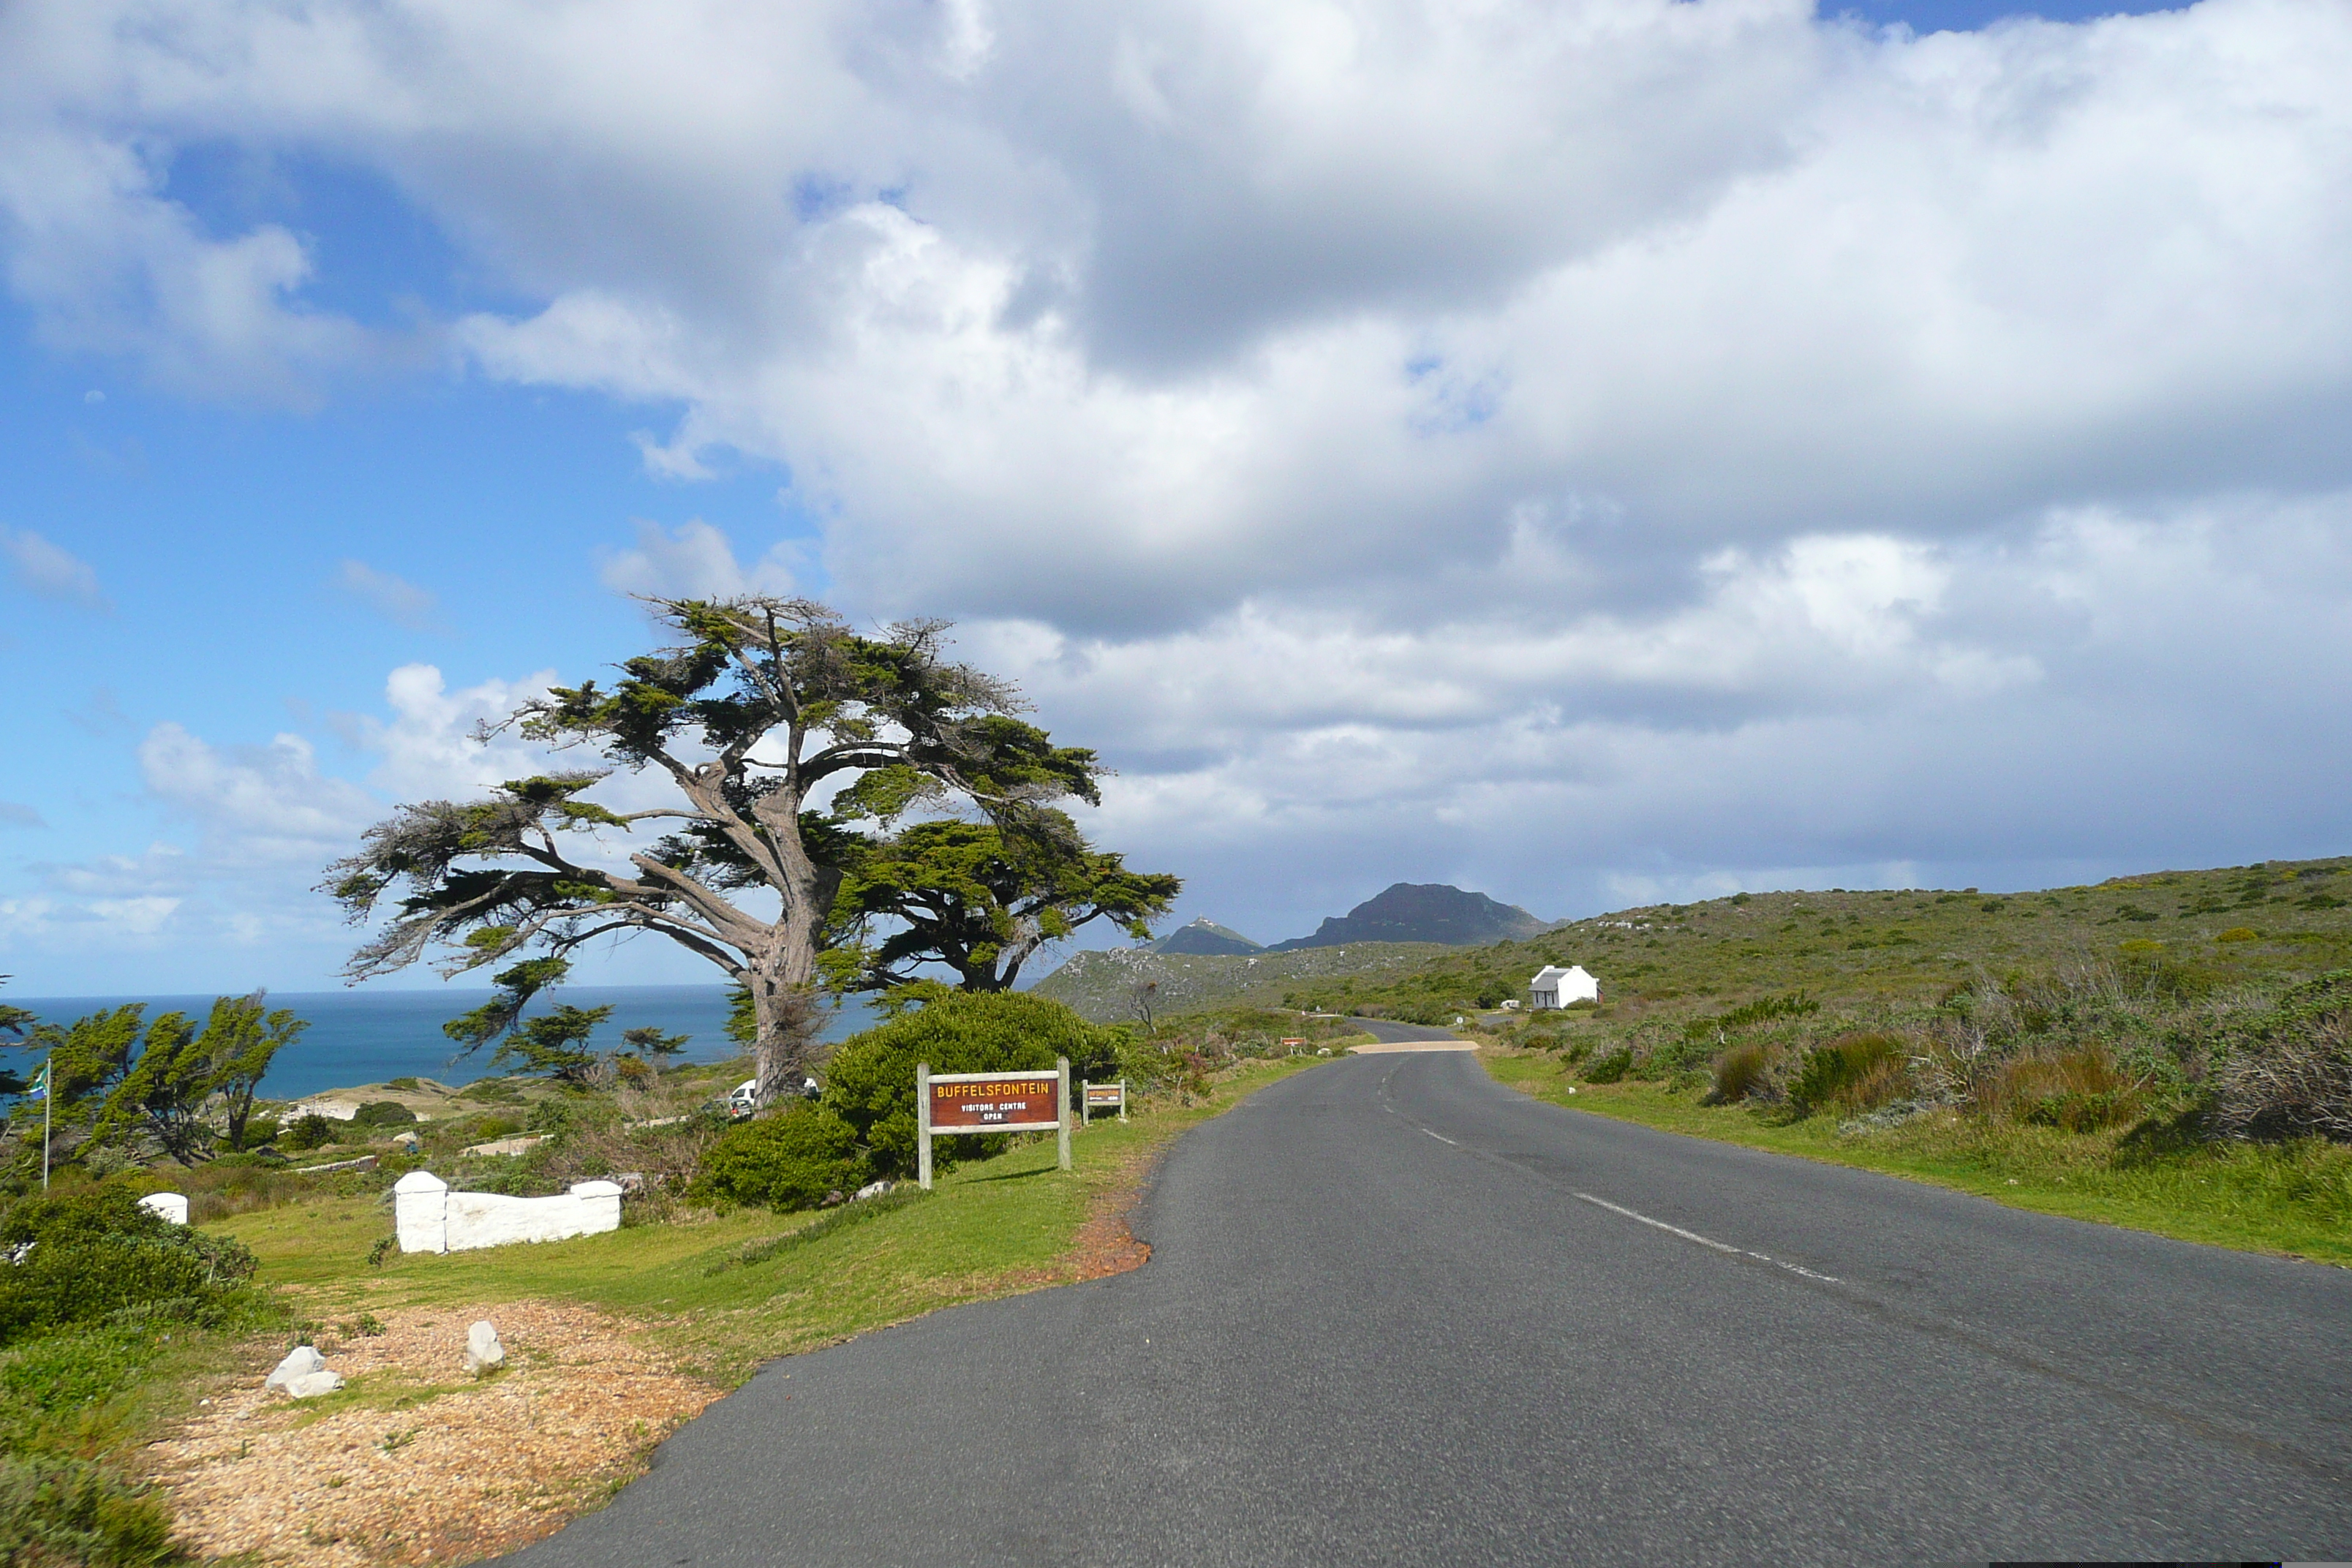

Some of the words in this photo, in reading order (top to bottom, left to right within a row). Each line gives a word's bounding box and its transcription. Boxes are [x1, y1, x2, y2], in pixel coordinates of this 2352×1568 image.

[937, 1082, 1049, 1098] BUFFELSFONTEIN
[961, 1103, 994, 1112] VISITORS
[999, 1102, 1026, 1110] CENTRE
[983, 1112, 1003, 1120] OPEN
